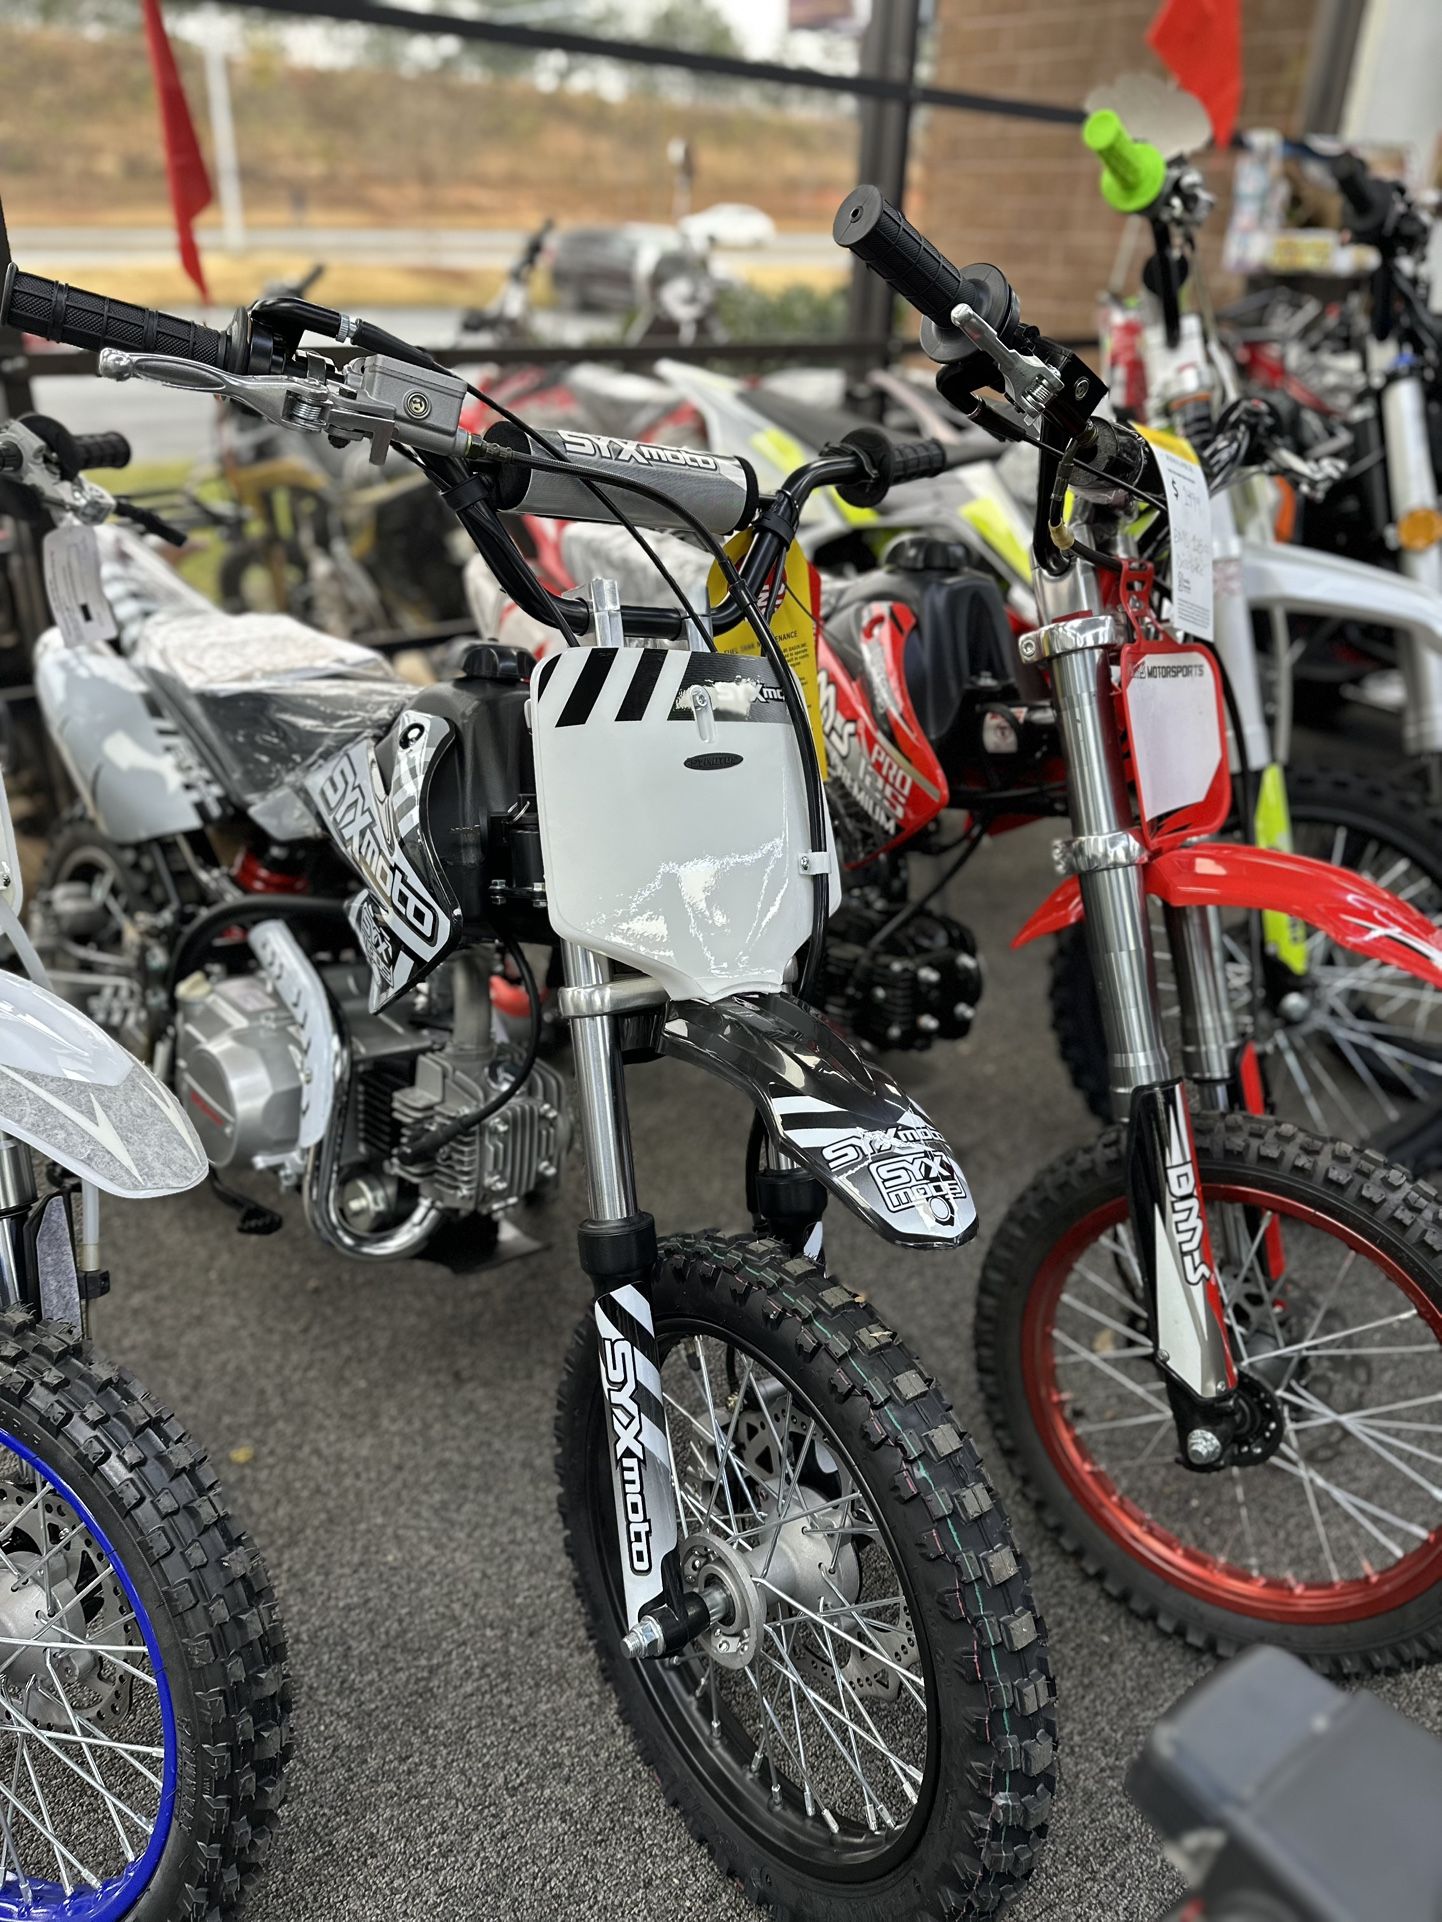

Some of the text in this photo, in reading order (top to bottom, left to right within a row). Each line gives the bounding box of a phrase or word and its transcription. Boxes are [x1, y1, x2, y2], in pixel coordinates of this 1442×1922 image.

[557, 430, 718, 471] SYXmoto
[1146, 664, 1204, 678] MOTORSPORTS
[871, 743, 913, 796] PRO
[321, 753, 438, 948] SYXmoto
[876, 1152, 952, 1190] SYX
[603, 1338, 653, 1576] SYXmoto
